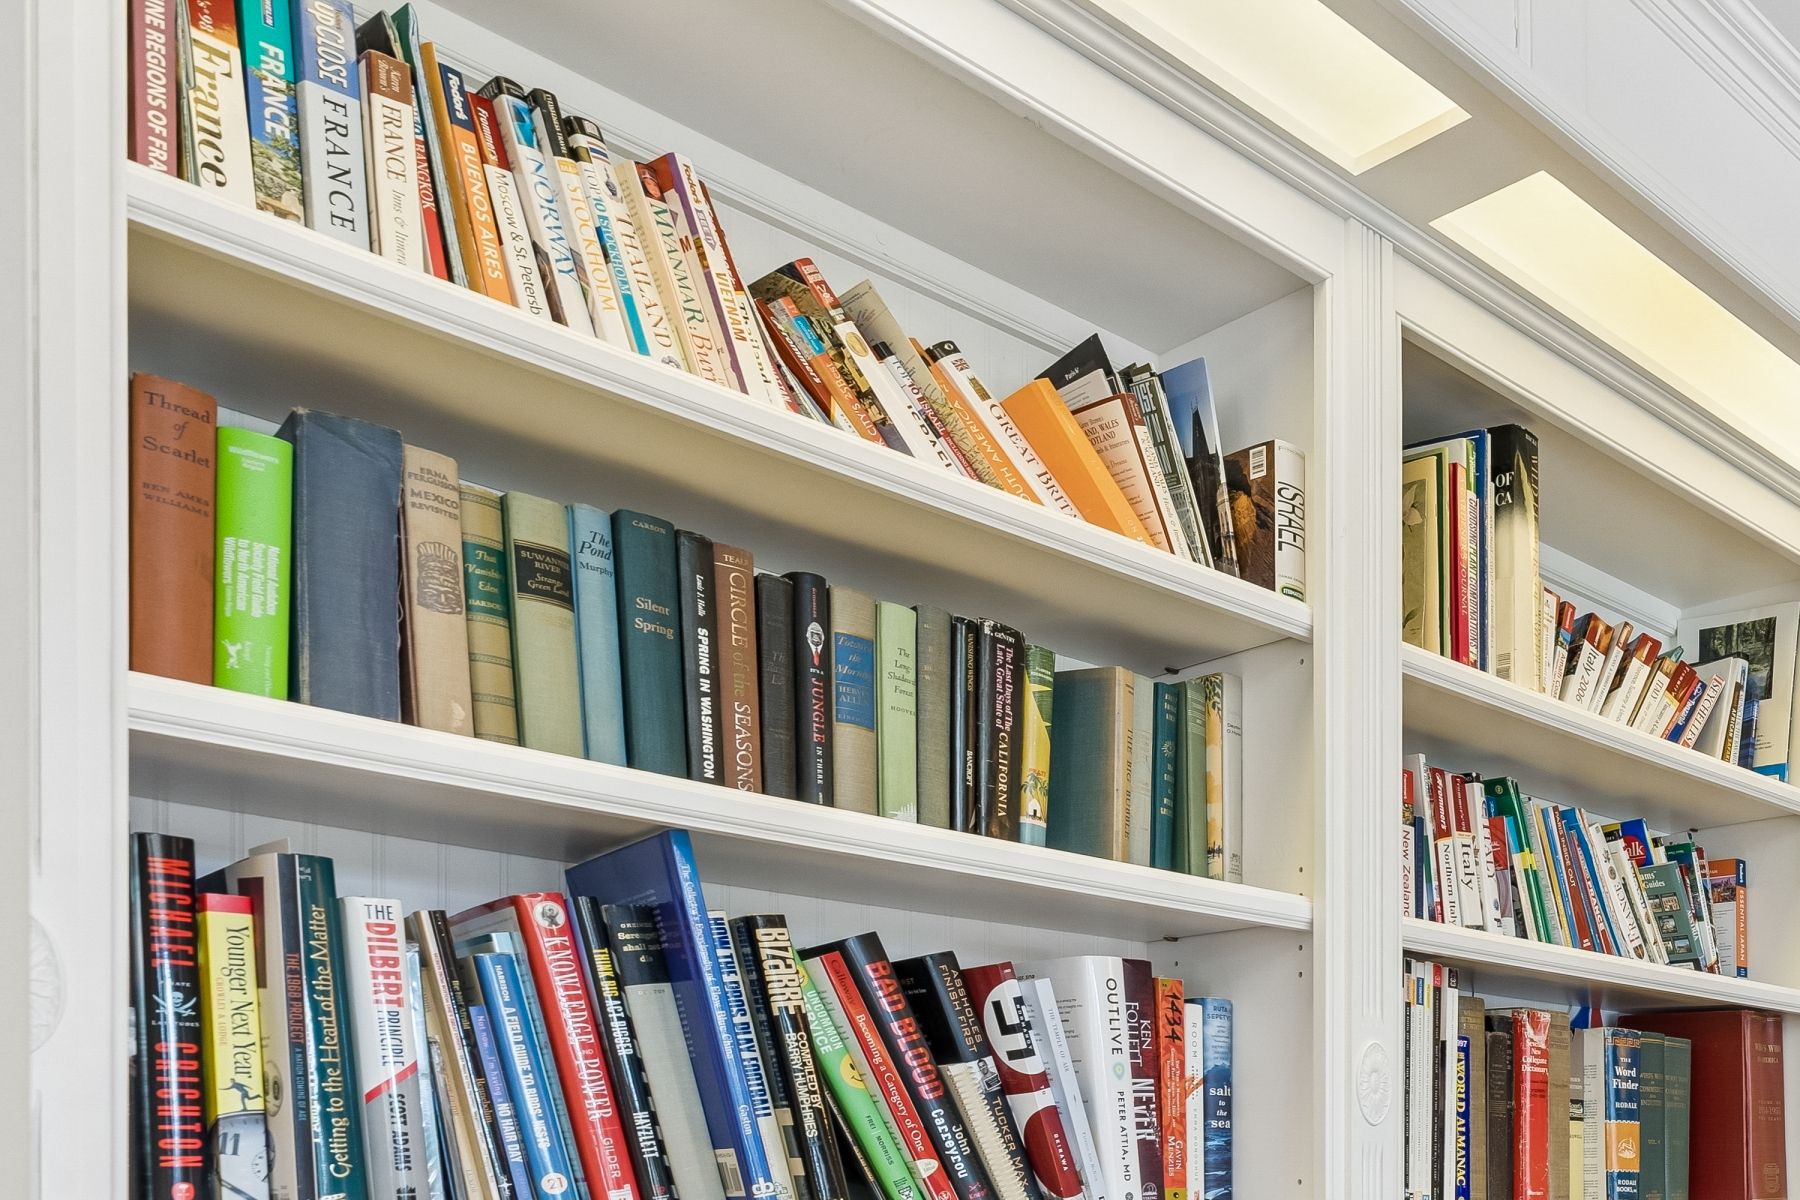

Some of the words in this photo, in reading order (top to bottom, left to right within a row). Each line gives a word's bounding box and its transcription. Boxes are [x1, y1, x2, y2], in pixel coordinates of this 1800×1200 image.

[145, 28, 168, 109] REGIONS
[258, 40, 292, 140] FRANCE
[192, 38, 237, 188] France
[322, 95, 357, 232] FRANCE
[381, 104, 407, 184] FRANCE
[415, 140, 436, 212] BANGKOK
[494, 170, 518, 230] Moscow
[461, 141, 490, 223] BUENOS
[479, 226, 503, 280] AIRES
[526, 154, 579, 283] NORWAY
[567, 184, 617, 311] STOCKHOLM
[614, 214, 672, 349] THAILAND
[714, 271, 748, 342] VIETNAM
[143, 390, 211, 425] Thread
[174, 421, 188, 441] of
[142, 436, 210, 469] Scarlet
[988, 401, 1040, 466] GREAT
[410, 488, 460, 511] MEXICO
[410, 501, 459, 521] REVISITED
[1277, 480, 1306, 553] ISRAEL
[578, 540, 613, 562] Pond
[589, 530, 611, 549] The
[631, 520, 667, 535] CARSON
[579, 560, 614, 579] Murphy
[634, 617, 675, 640] Spring
[635, 596, 671, 617] Silent
[729, 572, 749, 648] CIRCLE
[696, 627, 711, 679] SPRING
[1584, 647, 1600, 681] Italy
[700, 680, 711, 693] IN
[811, 677, 826, 744] JUNGLE
[699, 695, 716, 780] WASHINGTON
[733, 700, 754, 790] SEASONS
[997, 731, 1010, 818] CALIFORNIA
[1402, 829, 1412, 861] New
[1460, 842, 1477, 891] Italy
[147, 856, 196, 969] MICHAEL
[308, 903, 330, 962] Matter
[364, 904, 395, 921] THE
[220, 924, 251, 996] Younger
[312, 965, 333, 991] the
[364, 922, 405, 1009] DILBERT
[494, 964, 511, 1002] HARRISON
[313, 991, 334, 1012] of
[541, 934, 596, 1049] KNOWLEDGE
[938, 964, 962, 1013] FINISH
[956, 1013, 979, 1054] FIRST
[1105, 976, 1124, 1056] OUTLIVE
[230, 1000, 254, 1037] Next
[288, 1002, 305, 1045] PROJECT
[318, 1014, 341, 1063] Heart
[376, 1009, 405, 1068] PRINCIPLE
[806, 989, 843, 1052] UNCOMMON
[855, 1013, 884, 1066] Becoming
[864, 959, 907, 1015] BAD
[889, 1016, 946, 1101] BLOOD
[1124, 1001, 1143, 1068] FOLLETT
[1139, 1019, 1153, 1050] KEN
[1163, 990, 1184, 1045] 1434
[232, 1041, 257, 1080] Year
[1612, 1078, 1640, 1091] Finder
[1614, 1066, 1637, 1079] Word
[154, 1041, 204, 1169] CRICHTON
[388, 1093, 407, 1125] SCOTT
[577, 1057, 614, 1122] POWER
[882, 1072, 909, 1121] Category
[1115, 1090, 1127, 1123] PETER
[1209, 1086, 1232, 1098] salt
[1456, 1059, 1468, 1114] WORLD
[1615, 1100, 1638, 1110] RODALE
[632, 1110, 660, 1160] HAYZLETT
[739, 1104, 753, 1136] Gaston
[905, 1119, 916, 1133] of
[1210, 1119, 1232, 1130] sea
[1215, 1109, 1228, 1118] the
[328, 1116, 350, 1179] Getting
[392, 1126, 413, 1172] ADAMS
[602, 1136, 623, 1179] GILDER
[908, 1132, 926, 1154] One
[930, 1107, 969, 1180] Carreyrou
[952, 1123, 971, 1158] John
[992, 1095, 1016, 1152] TUCKER
[1008, 1156, 1030, 1188] MAX
[1119, 1125, 1130, 1161] ATTIA,
[1167, 1135, 1176, 1178] MENZIES
[1174, 1139, 1184, 1171] GAVIN
[1456, 1115, 1468, 1188] ALMANAC
[1122, 1163, 1133, 1183] MD
